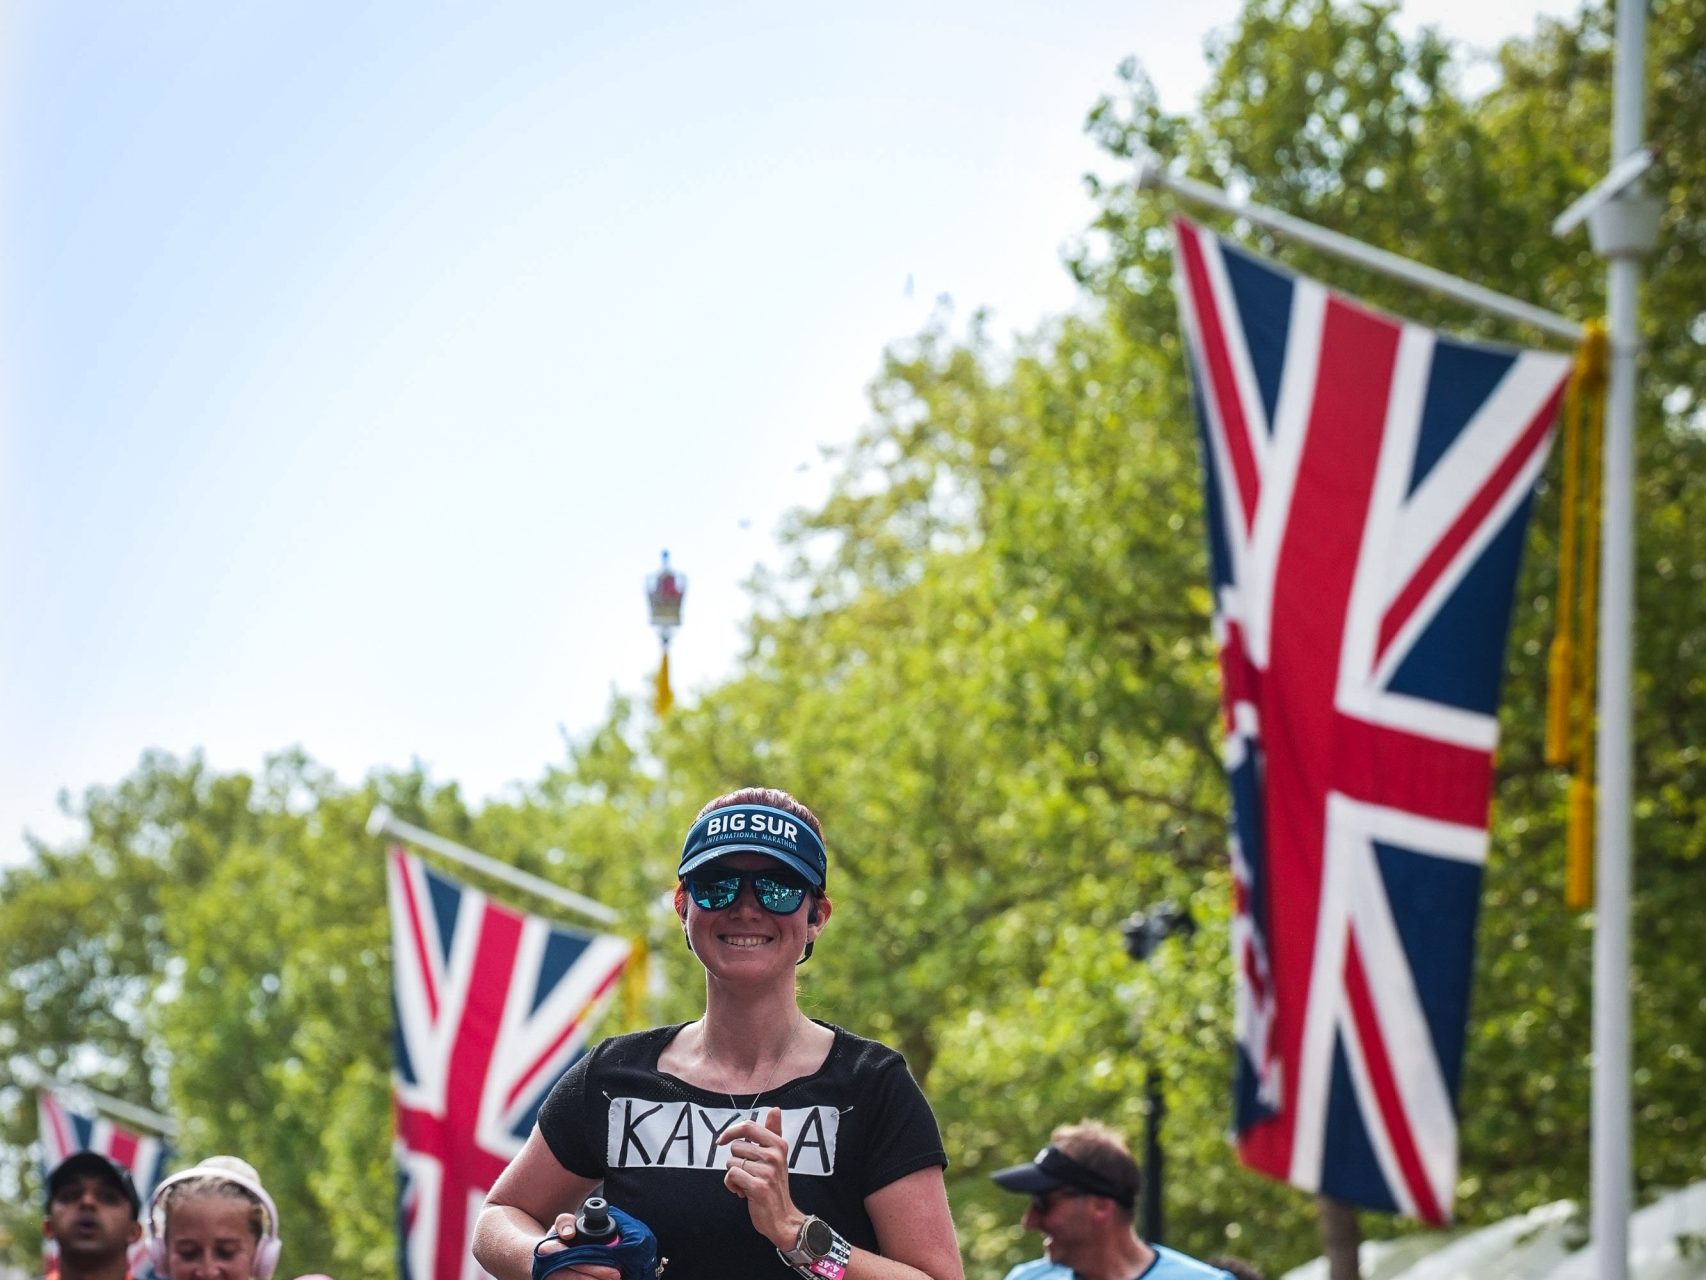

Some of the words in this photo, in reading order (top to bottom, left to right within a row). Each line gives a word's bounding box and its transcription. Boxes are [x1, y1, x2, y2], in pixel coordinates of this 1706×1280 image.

[705, 831, 758, 845] INTERNATIONAL
[761, 834, 797, 851] MARATHON
[706, 813, 746, 837] BIG
[750, 814, 798, 843] SUR
[618, 1099, 831, 1173] KAYA
